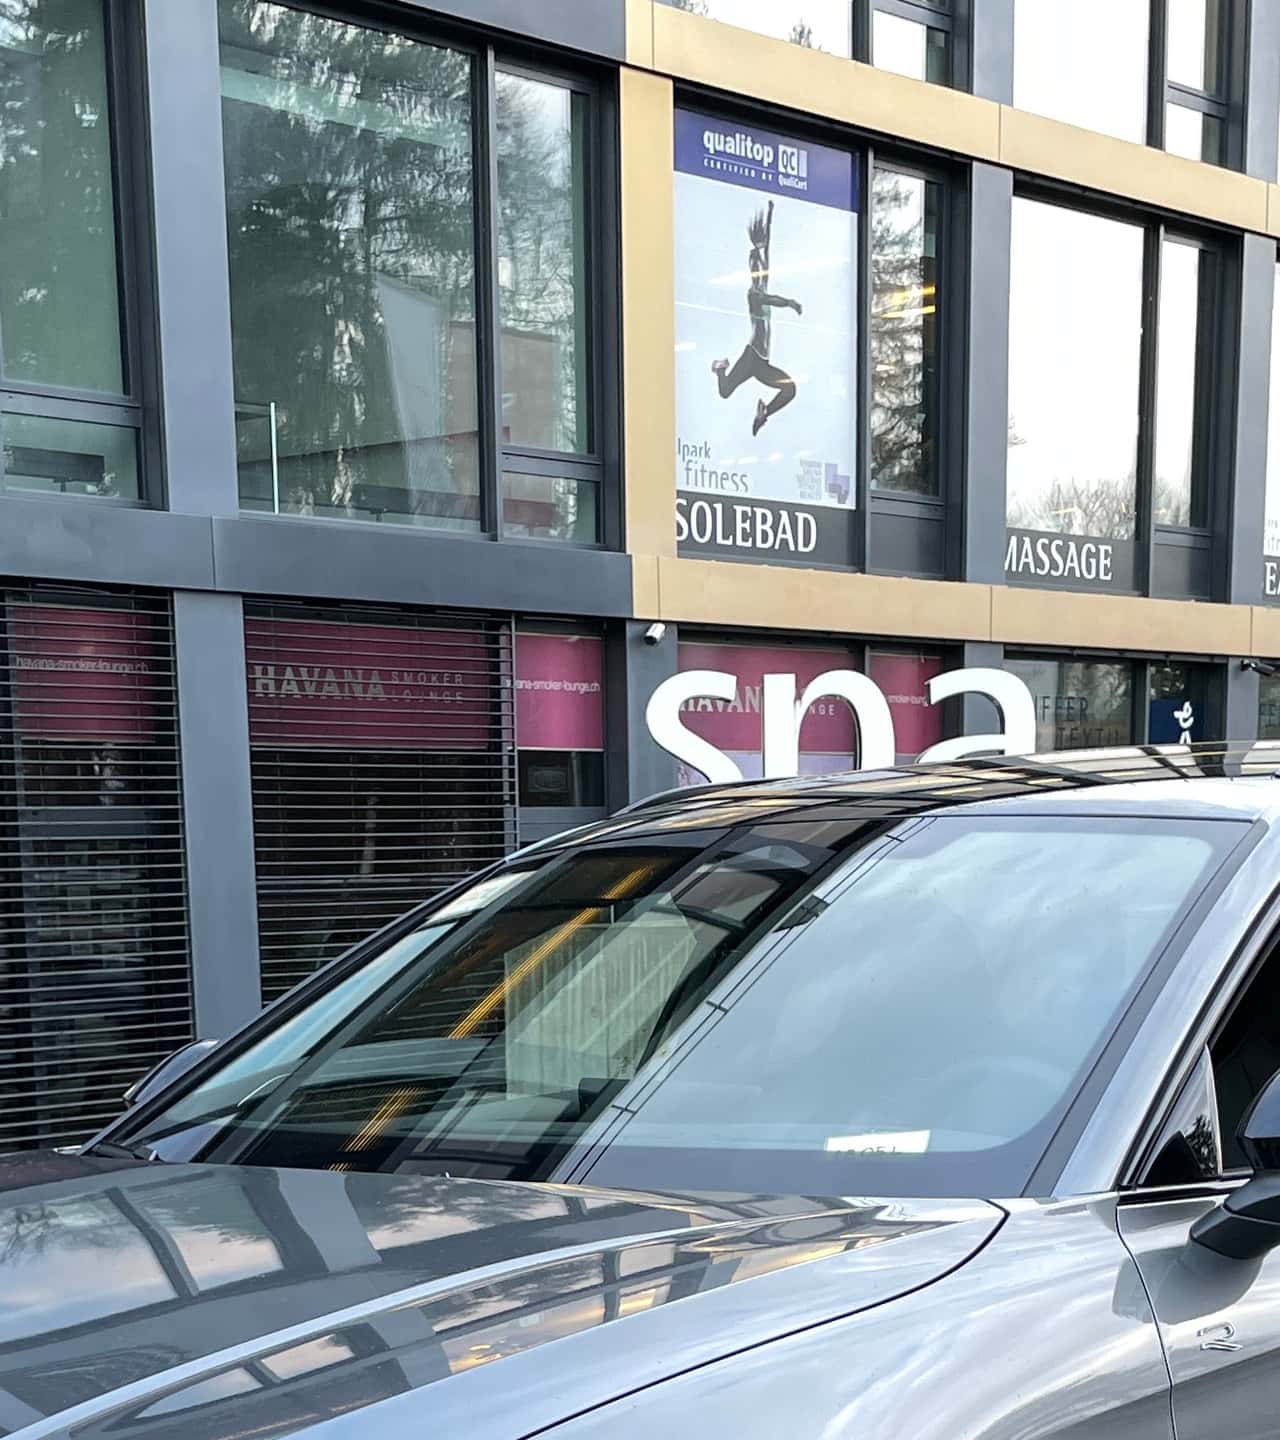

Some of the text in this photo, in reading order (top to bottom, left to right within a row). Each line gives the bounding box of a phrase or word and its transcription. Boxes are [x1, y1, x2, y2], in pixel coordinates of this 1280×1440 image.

[703, 130, 774, 167] qualitop
[684, 460, 749, 493] fitness
[675, 498, 817, 553] SOLEBAD
[253, 664, 386, 701] HAVANA
[390, 670, 466, 687] SMOKER
